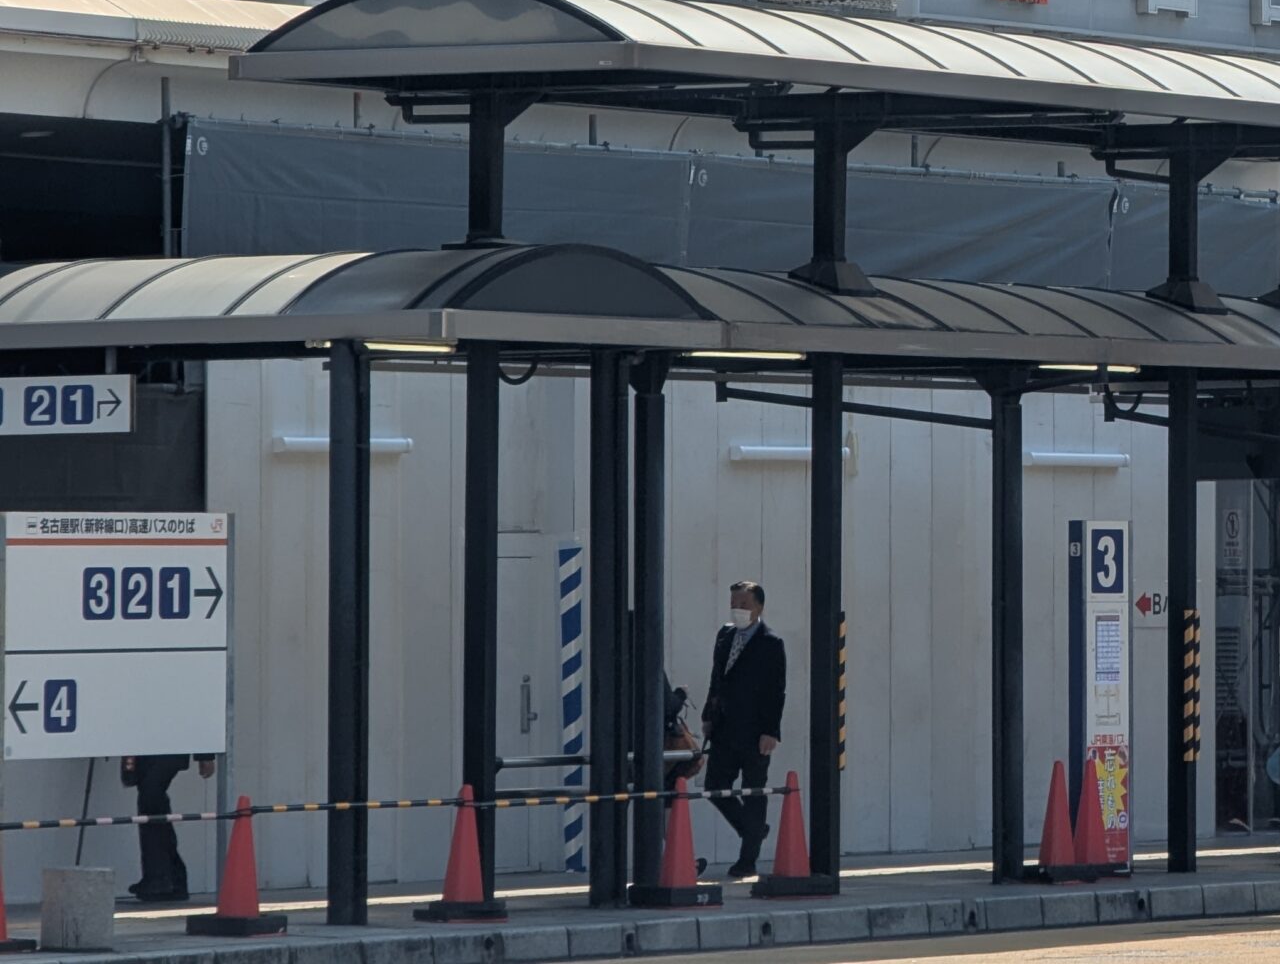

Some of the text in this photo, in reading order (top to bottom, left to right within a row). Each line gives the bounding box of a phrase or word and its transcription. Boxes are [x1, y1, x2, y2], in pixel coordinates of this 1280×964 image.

[30, 388, 50, 422] 2
[39, 518, 196, 534] 名古屋駅(新幹線口)高速バスのりば
[1097, 535, 1117, 588] 3
[89, 572, 109, 614] 3
[127, 572, 147, 614] 2
[50, 686, 72, 727] 4
